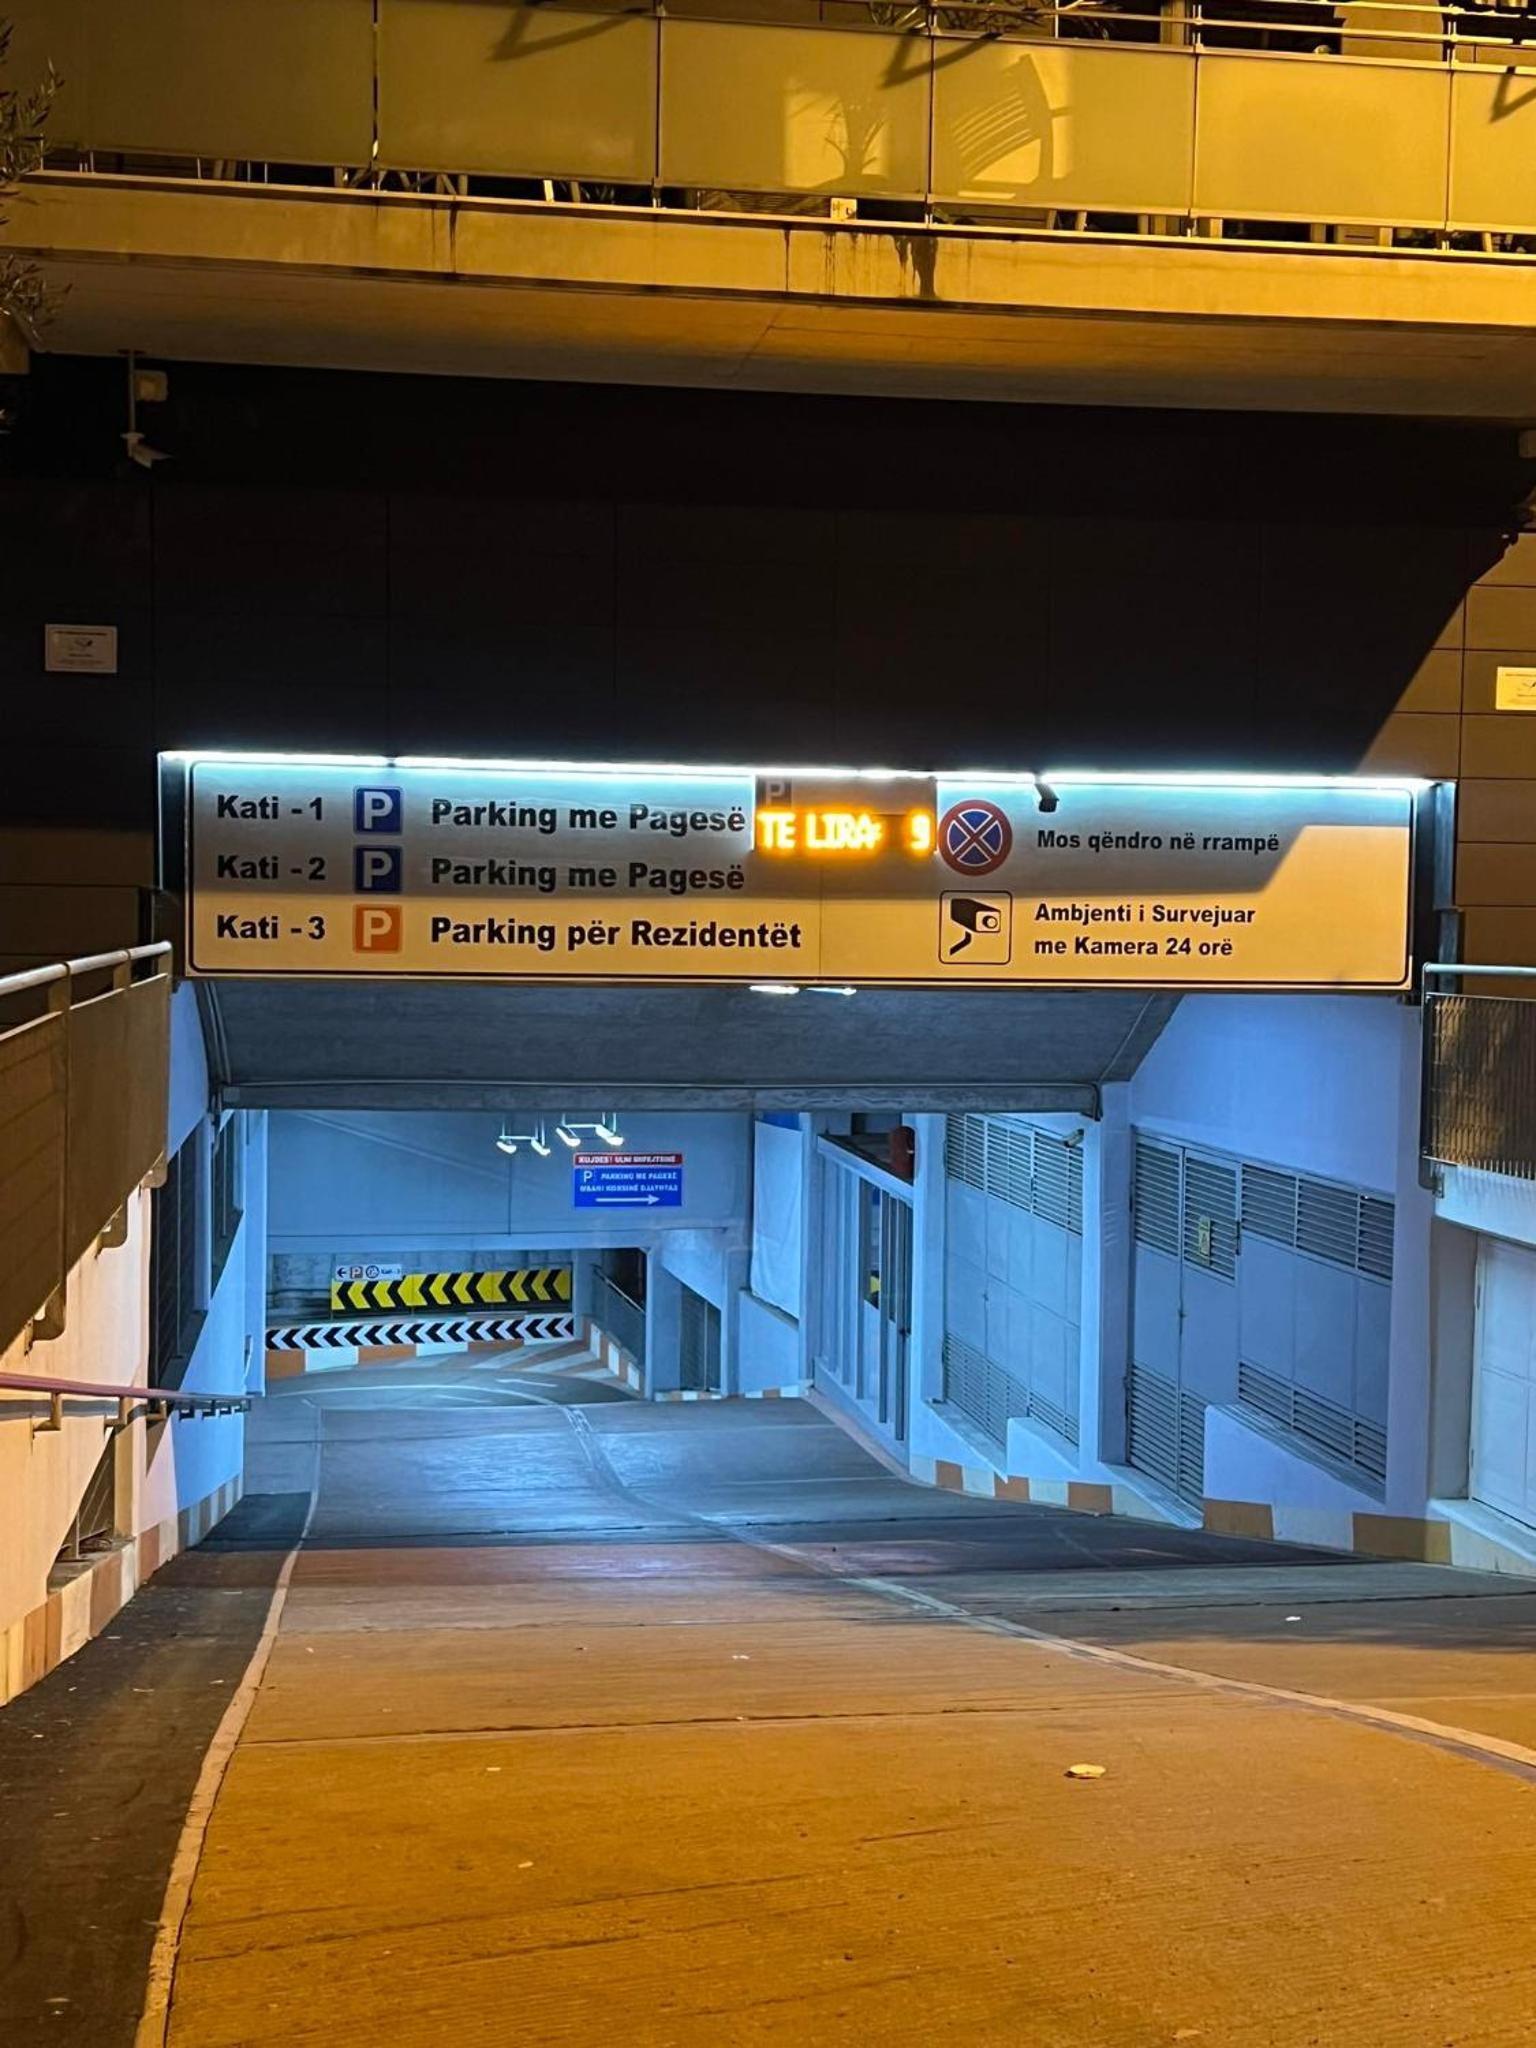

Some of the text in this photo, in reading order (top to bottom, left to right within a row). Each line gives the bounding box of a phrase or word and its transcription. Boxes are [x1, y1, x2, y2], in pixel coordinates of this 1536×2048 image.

[217, 795, 279, 819] Kati
[363, 791, 393, 829] P
[431, 799, 557, 834] Parking
[569, 808, 617, 829] me
[629, 804, 746, 837] Pagesë
[757, 811, 796, 850] TE
[911, 814, 931, 850] 9
[1038, 830, 1279, 855] Mos qëndro në rrampë
[217, 855, 279, 879] Kati
[363, 851, 393, 888] P
[431, 857, 557, 892] Parking
[568, 866, 616, 888] me
[628, 862, 745, 895] Pagesë
[217, 915, 278, 939] Kati
[363, 910, 393, 948] P
[431, 917, 556, 951] Parking
[568, 920, 620, 951] për
[631, 920, 801, 948] Rezidentët
[1035, 903, 1255, 927] Ambjenti i Survejuar
[1035, 937, 1233, 956] me Kamera 24 orë
[583, 1170, 593, 1182] P
